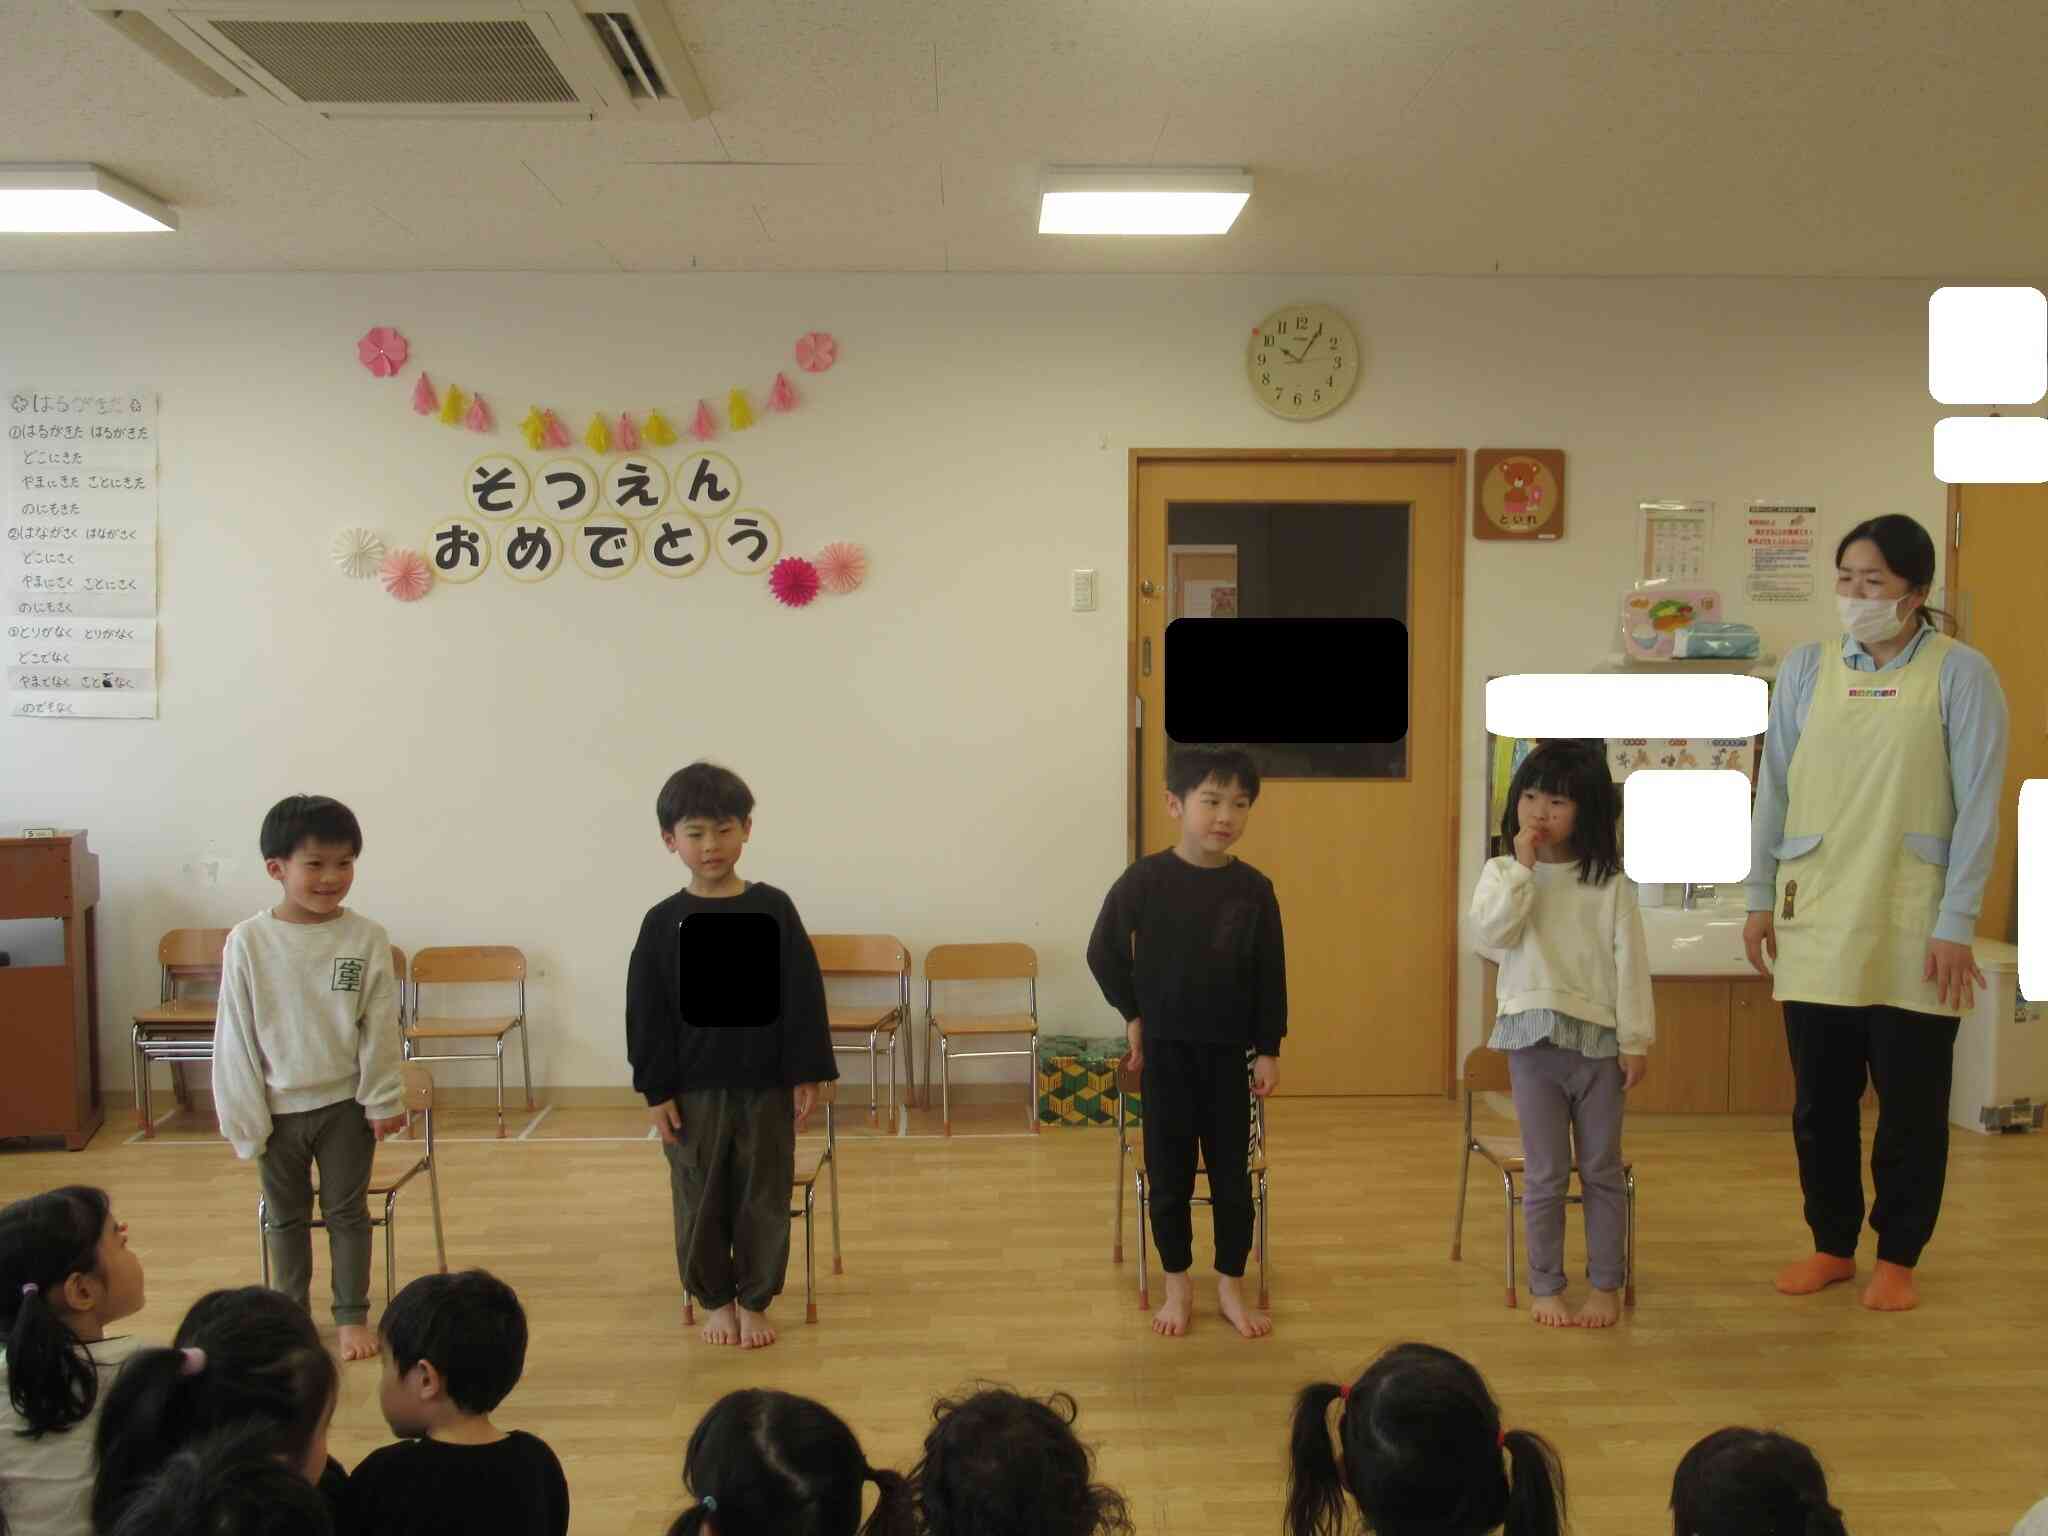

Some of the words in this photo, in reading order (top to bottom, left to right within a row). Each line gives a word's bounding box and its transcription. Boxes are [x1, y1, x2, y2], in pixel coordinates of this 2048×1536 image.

[1278, 320, 1287, 334] 11
[1296, 316, 1309, 330] 12
[1329, 336, 1338, 350] 2
[1257, 353, 1266, 366] 9
[1332, 355, 1342, 369] 3
[1261, 371, 1271, 385] 8
[1325, 375, 1333, 387] 4
[1274, 386, 1284, 401] 7
[1293, 392, 1302, 406] 6
[1312, 388, 1321, 402] 5
[90, 425, 149, 440] はるがきた
[23, 449, 83, 465] どこにきた
[22, 474, 80, 490] やまにきた
[472, 457, 731, 512] そつえん
[22, 503, 81, 516] のにもきた
[85, 527, 137, 541] はながさく
[435, 518, 768, 571] おめでとう
[23, 551, 75, 565] どこにさく
[84, 628, 135, 640] とりがなく
